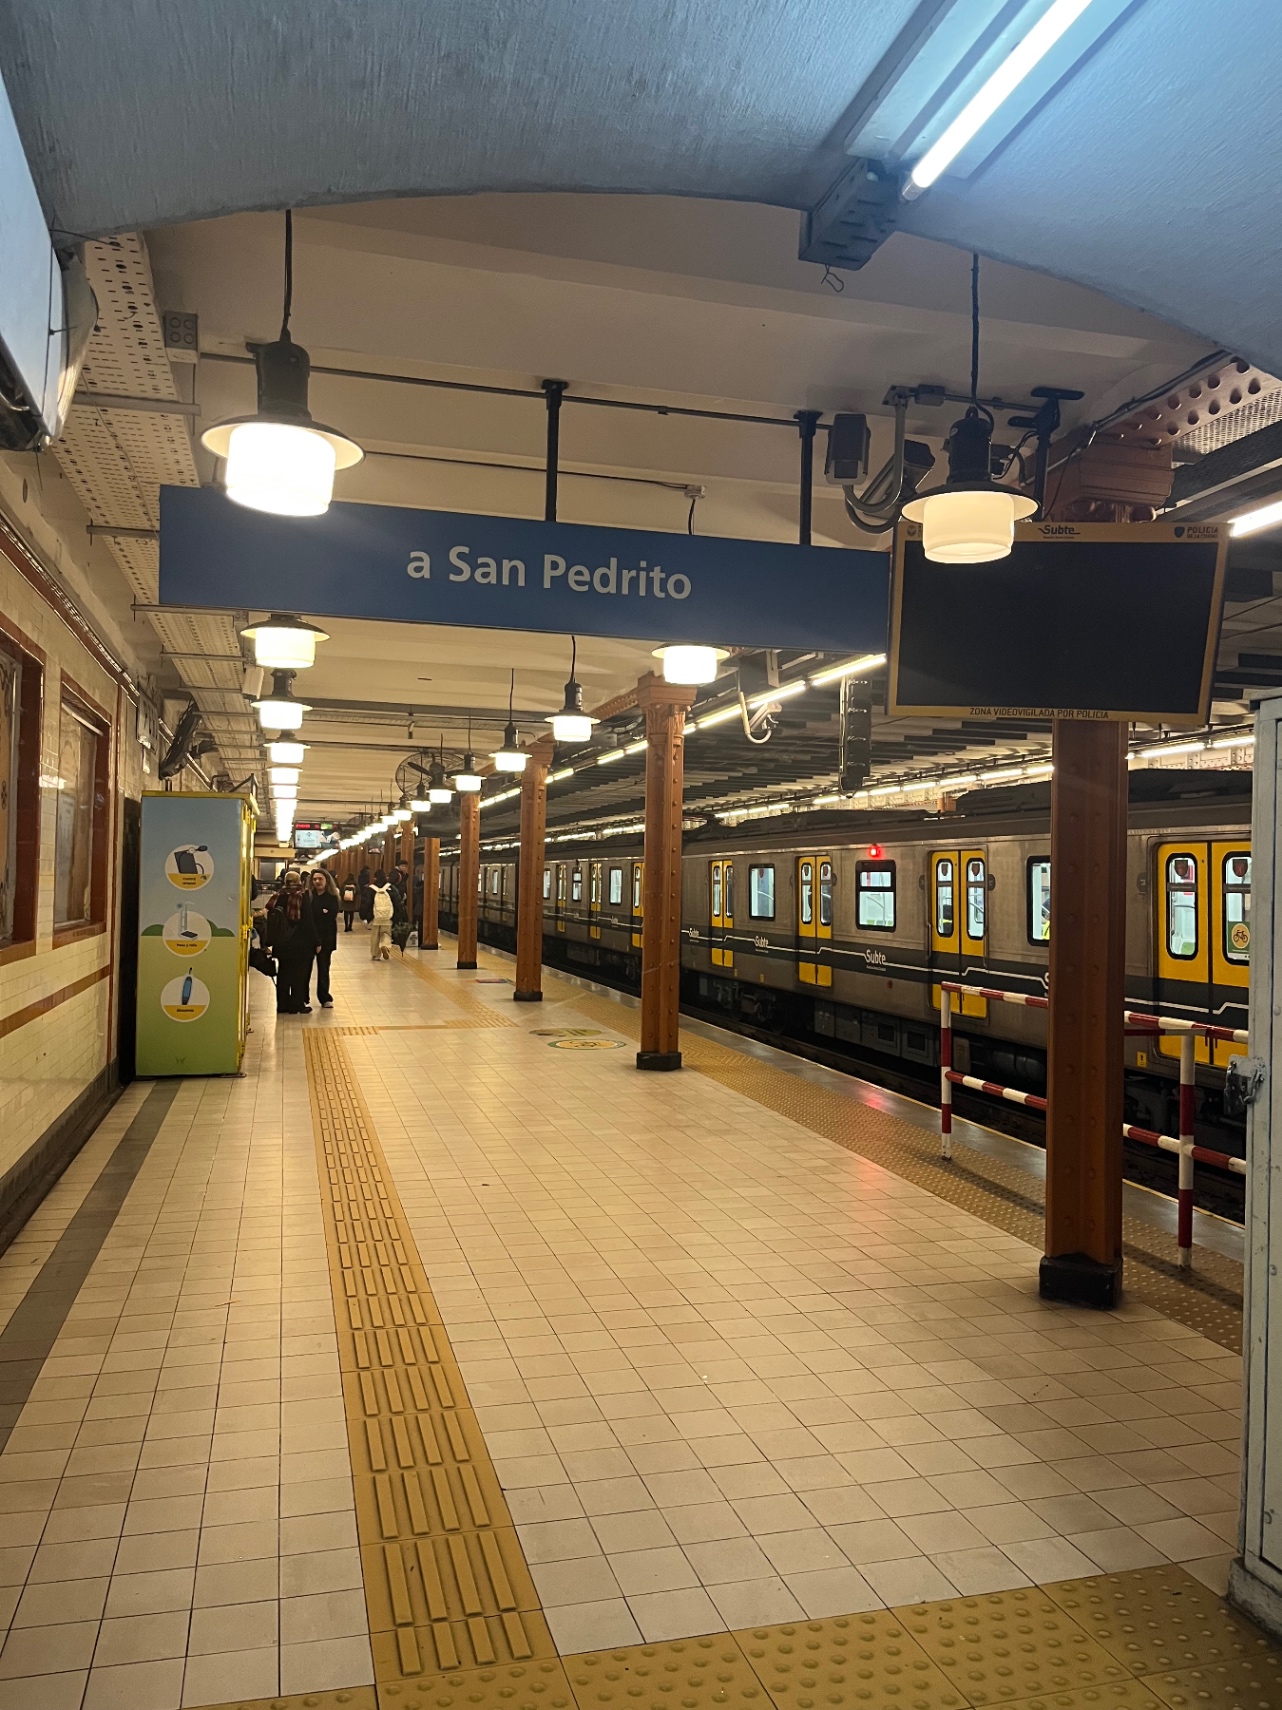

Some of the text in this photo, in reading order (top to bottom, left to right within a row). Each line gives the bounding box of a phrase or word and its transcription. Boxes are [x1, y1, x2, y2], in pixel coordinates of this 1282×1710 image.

[1038, 524, 1081, 535] Subte
[406, 546, 692, 600] a San Pedrito
[969, 707, 1109, 719] ZONA VIDEOVIGILADA POR POLICIA
[865, 949, 886, 965] Subte
